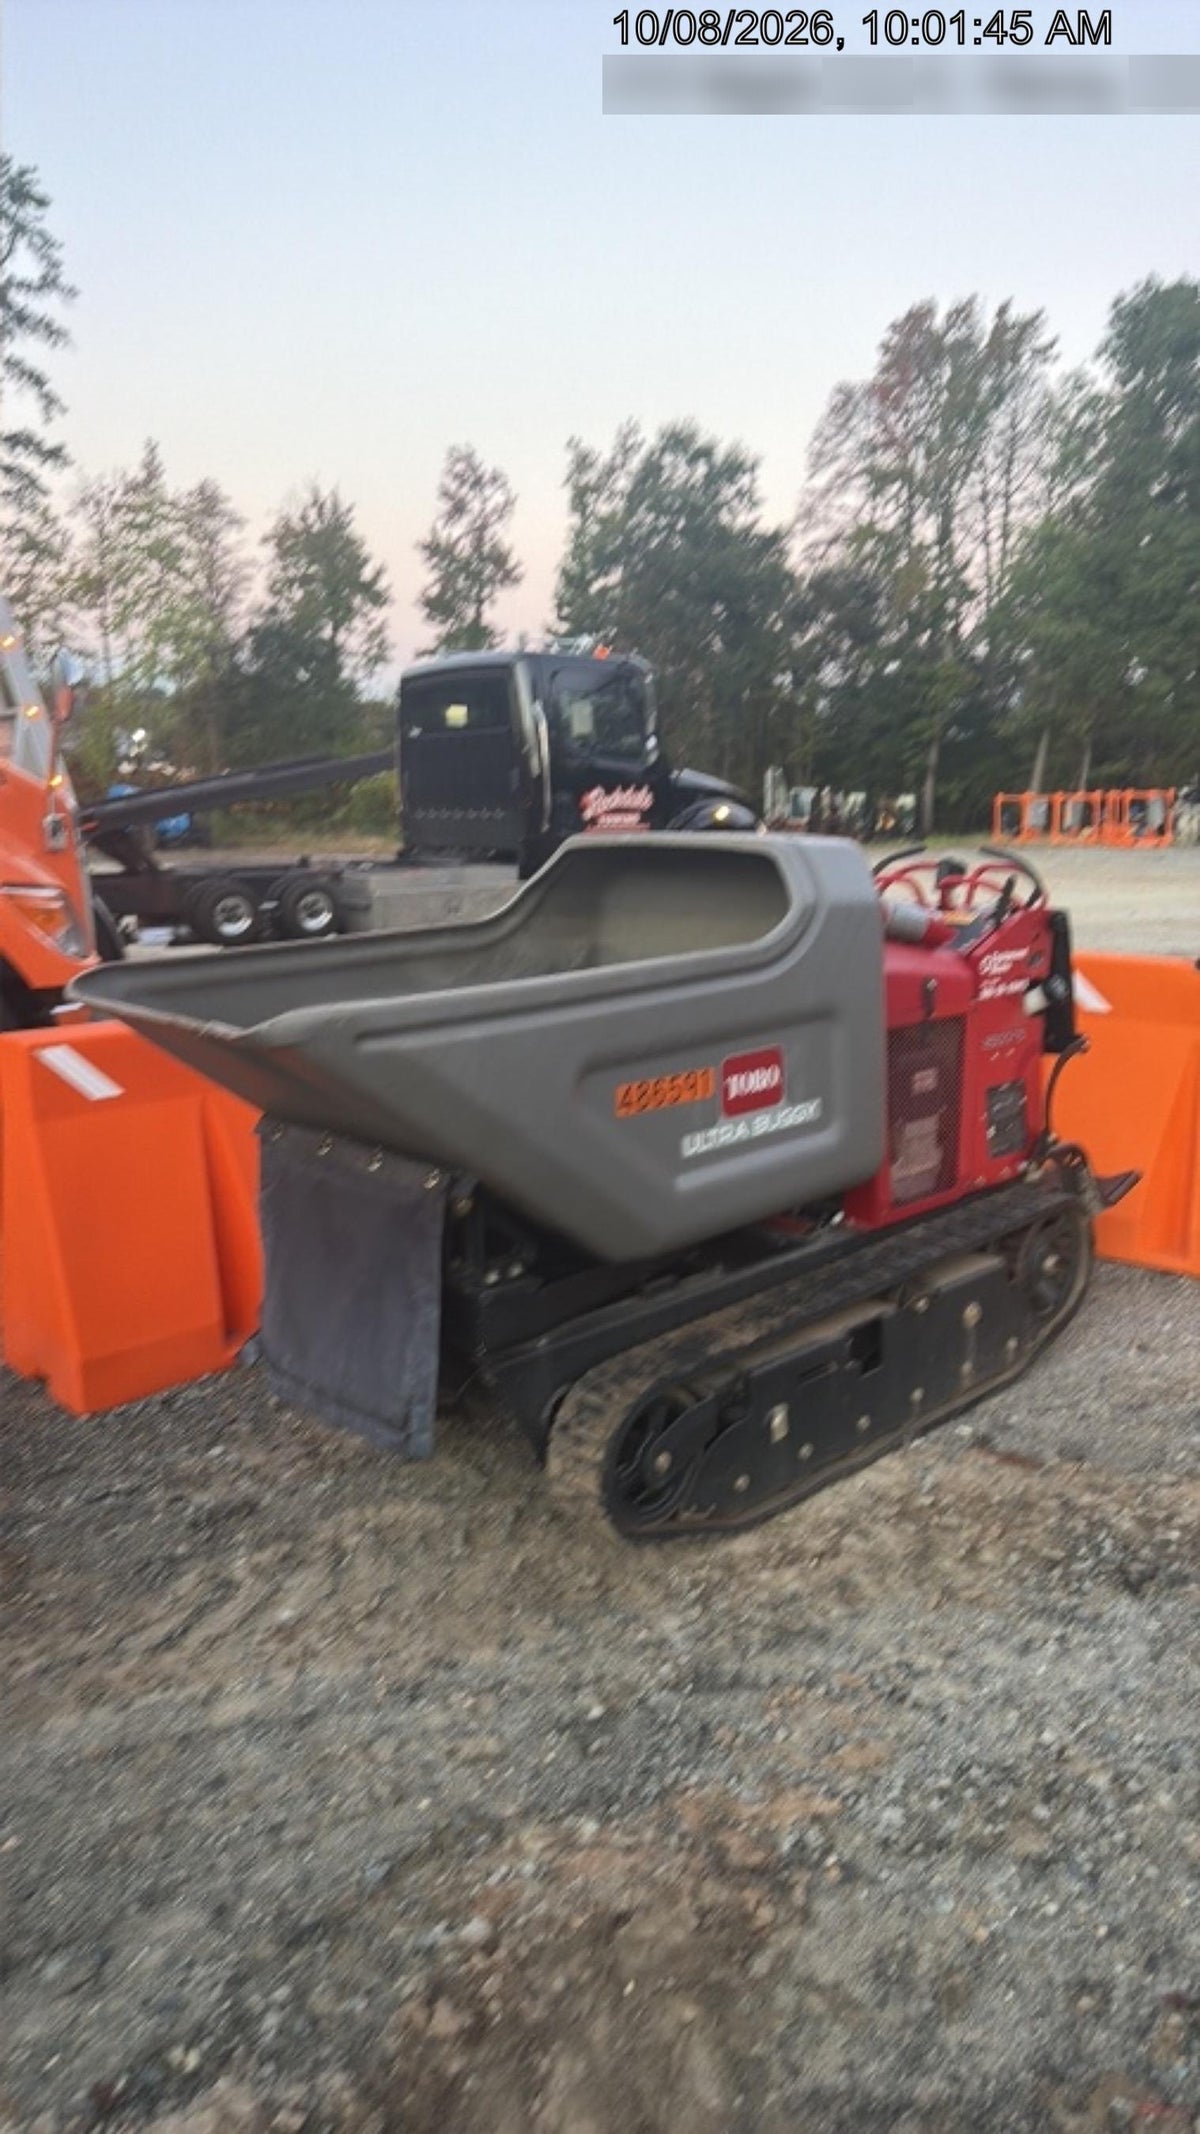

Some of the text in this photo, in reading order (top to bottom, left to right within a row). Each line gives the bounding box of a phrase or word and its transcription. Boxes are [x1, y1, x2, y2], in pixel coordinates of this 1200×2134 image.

[614, 1066, 715, 1119] 486591
[725, 1064, 781, 1101] TORO
[681, 1097, 823, 1158] ULTRA BUGGY
